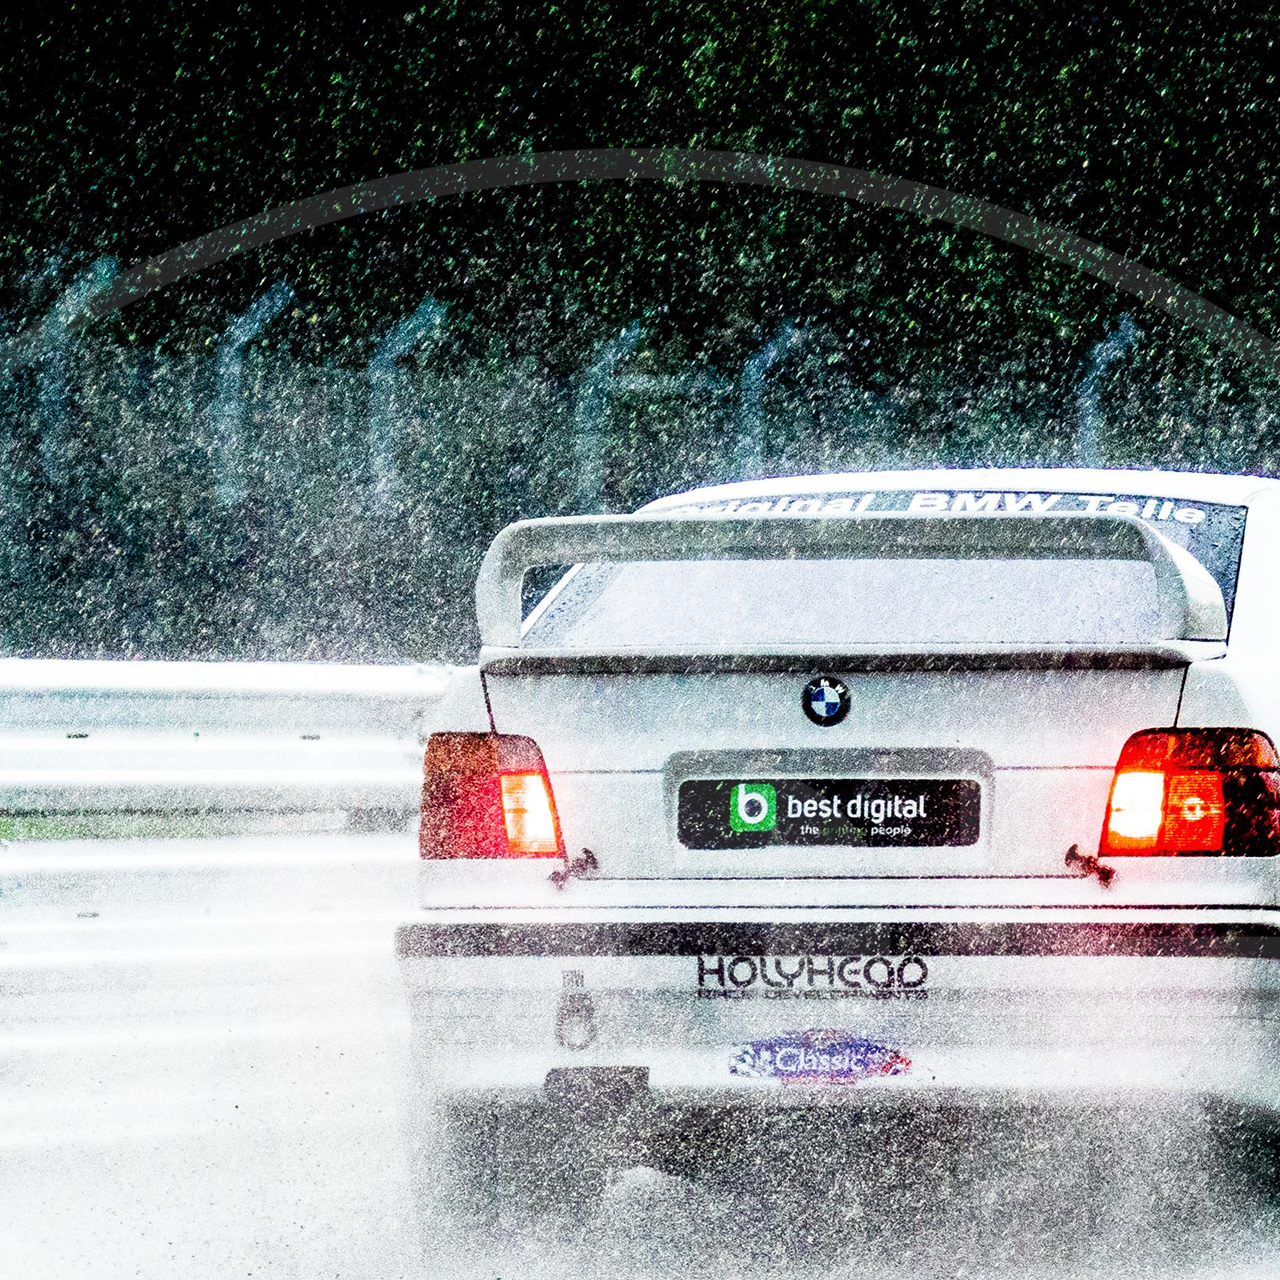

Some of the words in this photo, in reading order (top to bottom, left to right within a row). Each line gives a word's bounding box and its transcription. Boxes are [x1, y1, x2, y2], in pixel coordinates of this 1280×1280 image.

[908, 492, 1062, 513] BMW
[1077, 496, 1206, 524] Teile
[787, 795, 842, 818] best
[847, 794, 927, 823] digital
[800, 824, 819, 836] the
[870, 824, 912, 837] people
[697, 954, 929, 988] HOLYHEAD
[776, 1047, 864, 1072] Classic
